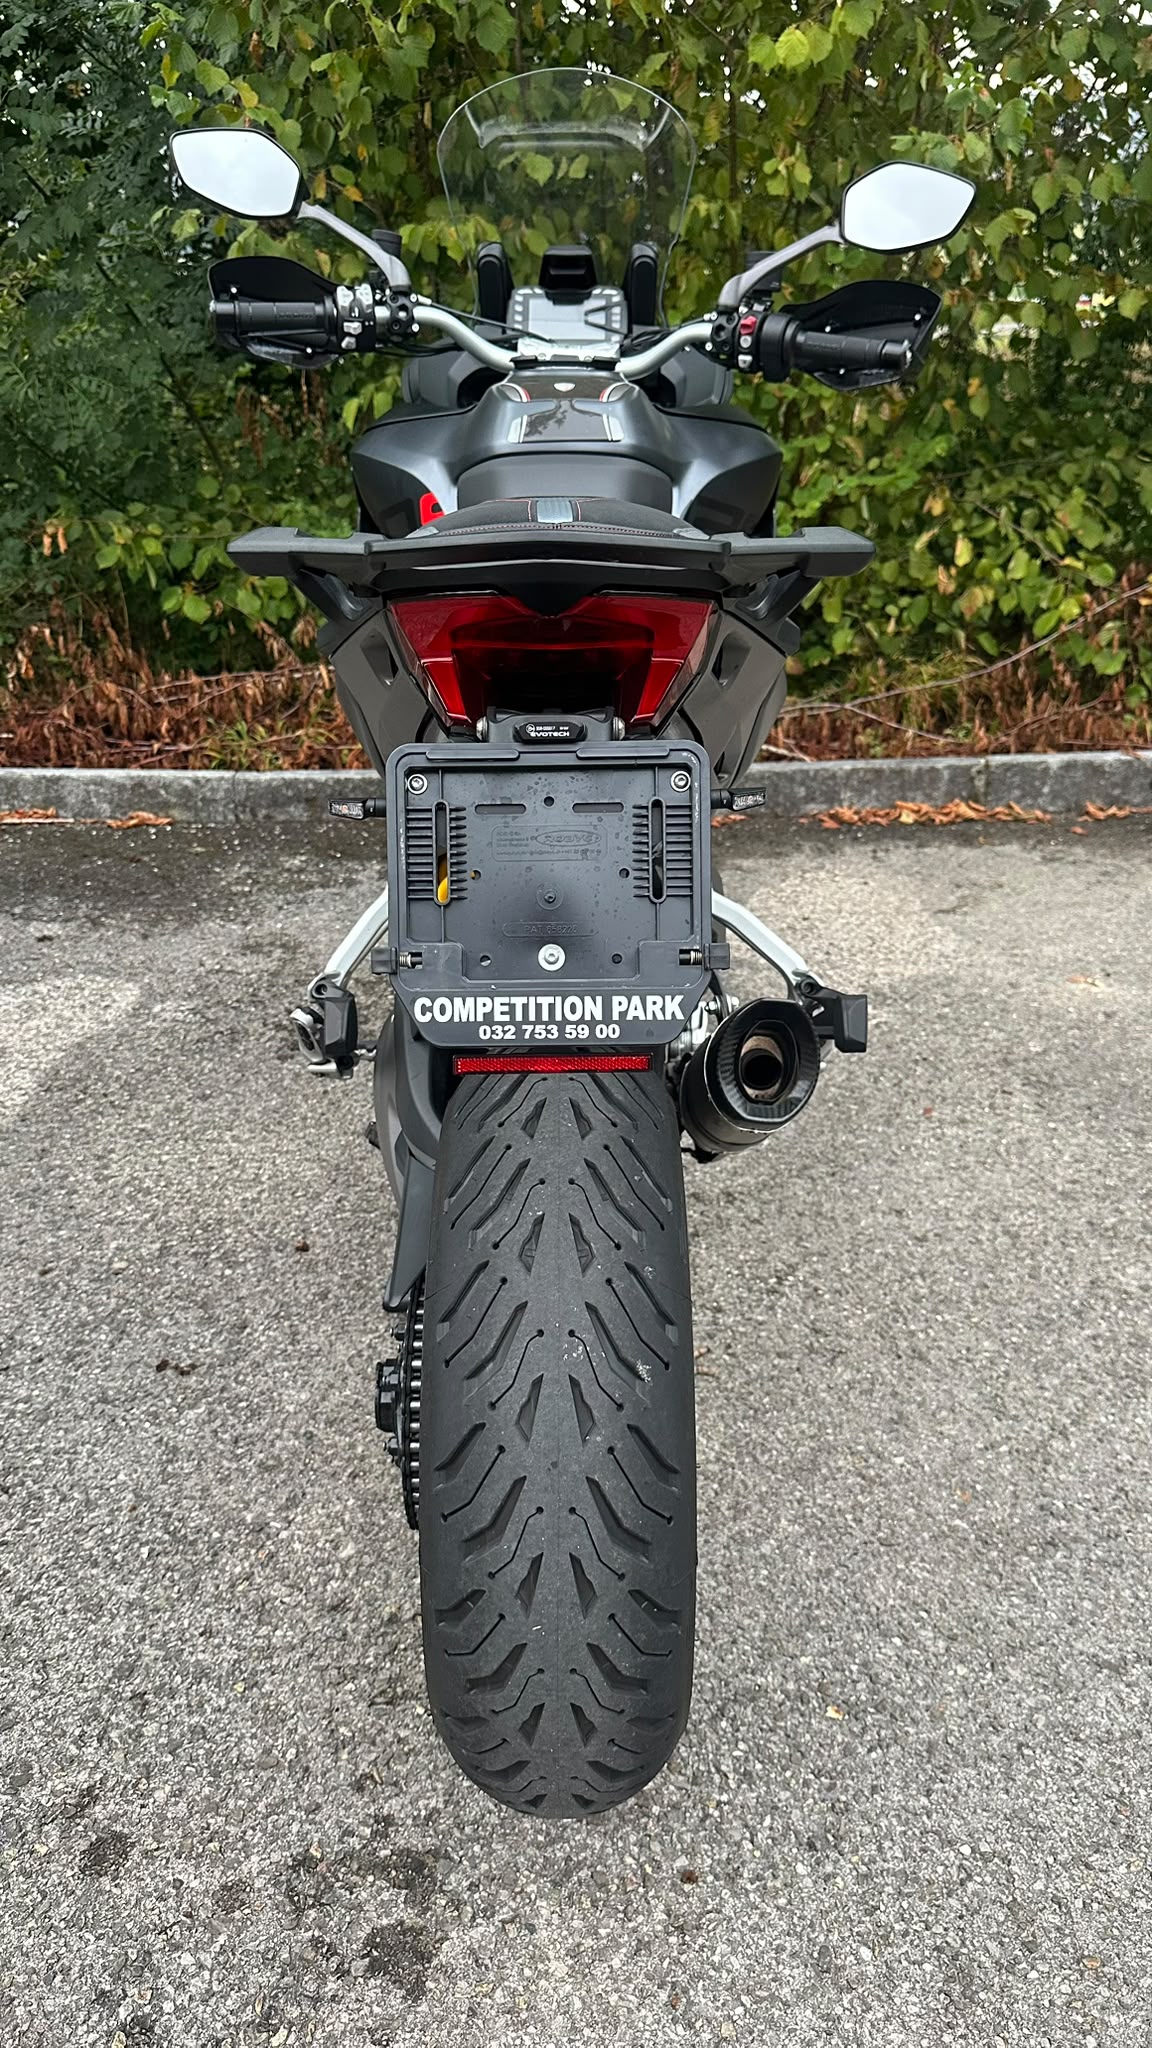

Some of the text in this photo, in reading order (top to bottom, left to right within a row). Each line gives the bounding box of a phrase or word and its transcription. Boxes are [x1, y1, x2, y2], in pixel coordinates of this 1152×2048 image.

[413, 995, 685, 1023] COMPETITION PARK
[478, 1023, 621, 1039] 032 753 59 00
